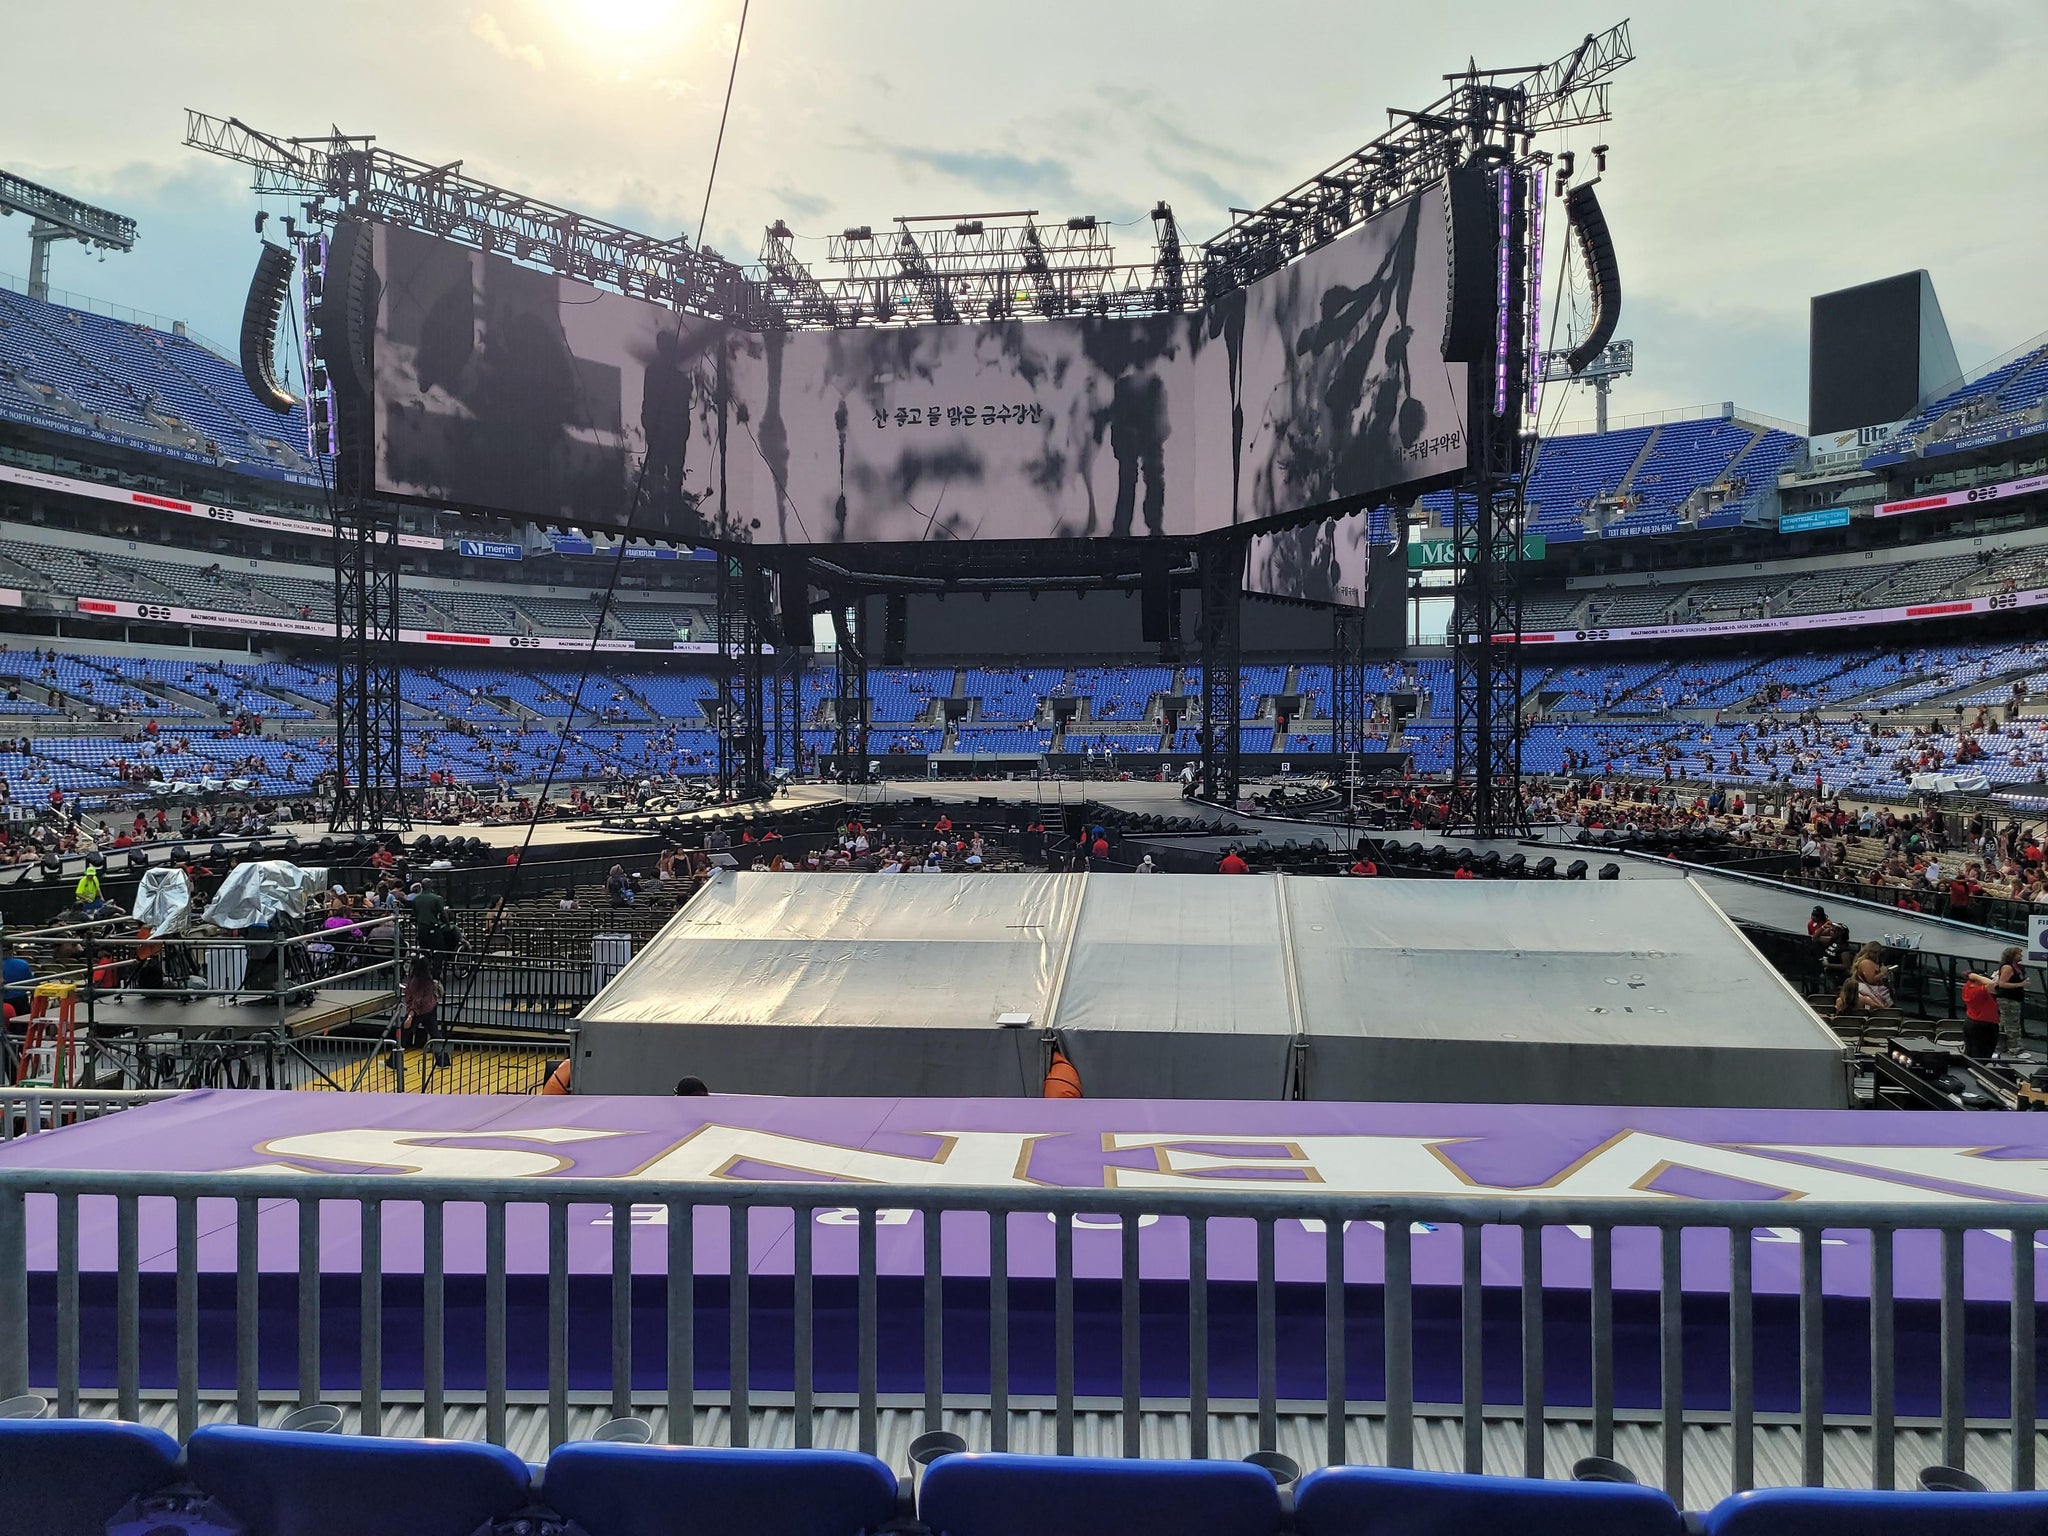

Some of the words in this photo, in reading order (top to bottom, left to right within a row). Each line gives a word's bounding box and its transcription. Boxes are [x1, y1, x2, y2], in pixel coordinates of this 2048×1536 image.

[9, 410, 31, 423] NORTH
[32, 416, 70, 432] CHAMPIONS
[872, 408, 889, 428] 산
[894, 407, 922, 428] 좋고
[927, 406, 942, 426] 물
[981, 403, 1043, 425] 금수강산
[1857, 426, 1888, 447] Lite
[2020, 423, 2046, 435] EARNEST
[1409, 430, 1461, 461] 국립국악원
[1955, 439, 1972, 449] RING
[1975, 434, 1997, 446] HONOR
[485, 545, 515, 555] merritt
